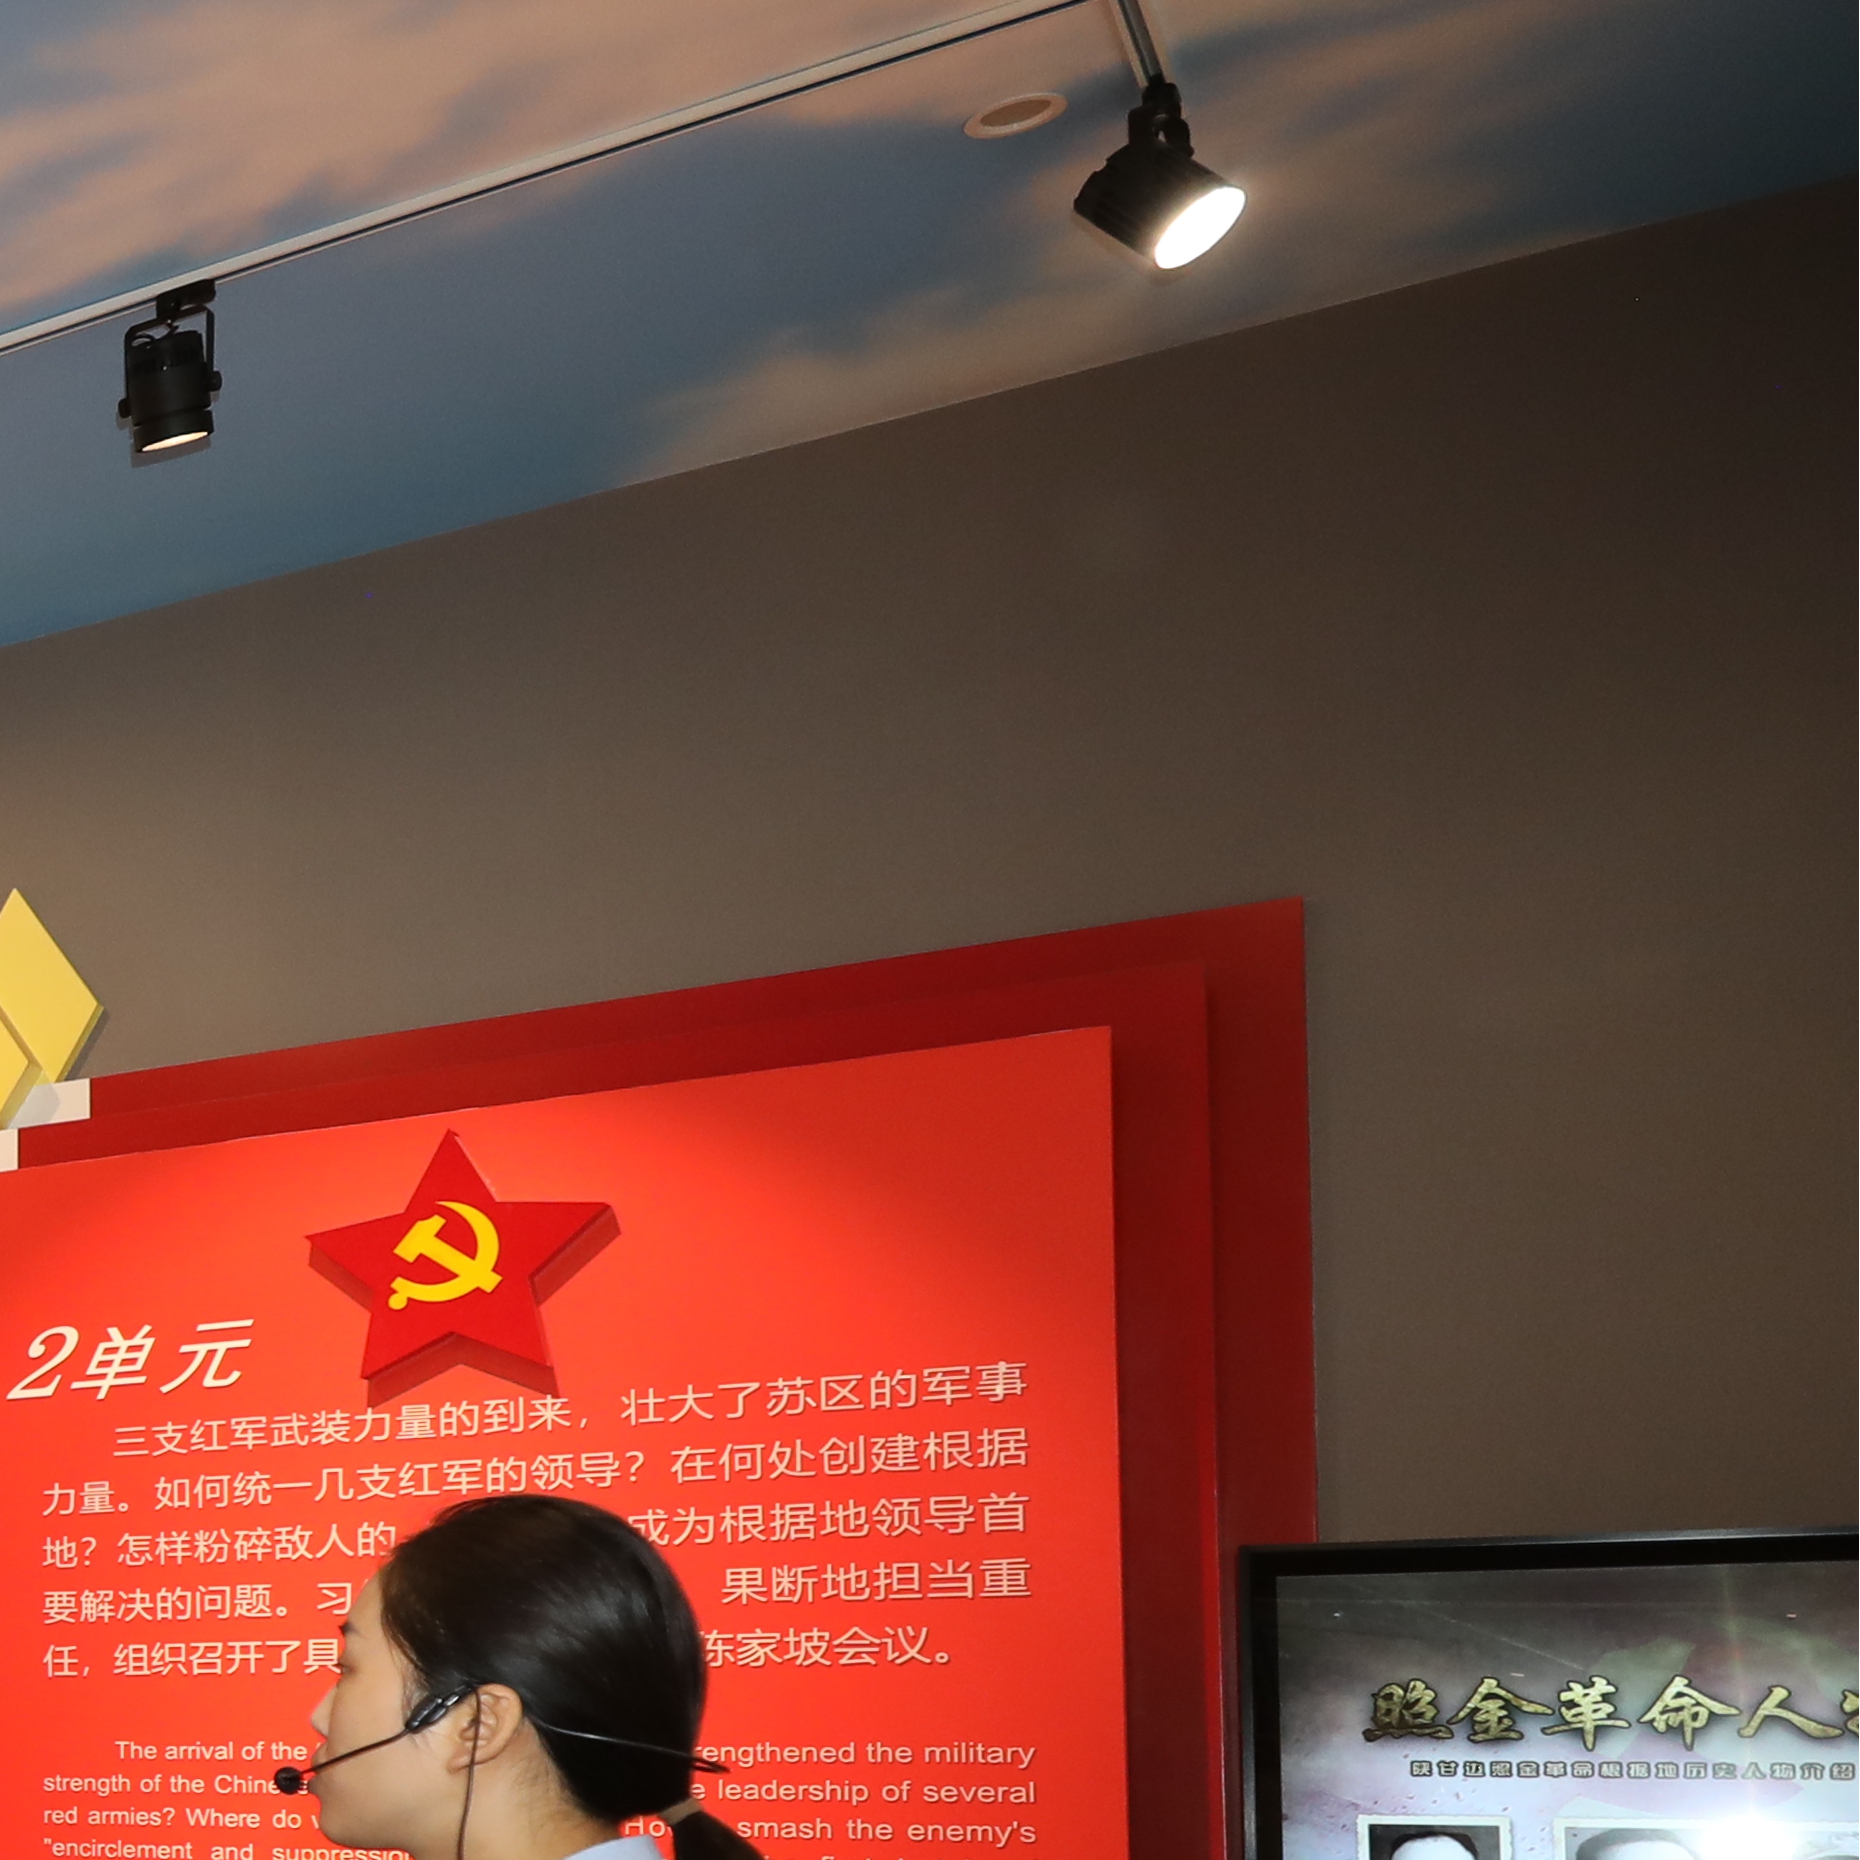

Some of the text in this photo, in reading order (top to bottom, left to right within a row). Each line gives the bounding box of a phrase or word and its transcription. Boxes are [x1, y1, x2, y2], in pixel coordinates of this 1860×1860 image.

[6, 1319, 255, 1401] 2单元
[112, 1361, 1029, 1460] 三支红军武装力量的到来，壮大了苏区的军事
[42, 1427, 1030, 1517] 力量。如何统一几支红军的领导？在何处创建根据
[720, 1557, 1032, 1605] 果断地担当重
[42, 1636, 342, 1680] 任，组织召开了具
[1362, 1675, 1860, 1752] 照金革命人
[115, 1741, 1035, 1768] The arrival of the rengthened the military
[43, 1774, 130, 1796] strength
[140, 1774, 161, 1794] of
[169, 1775, 205, 1794] the
[214, 1775, 309, 1796] Chinee
[718, 1780, 868, 1806] leadership
[882, 1780, 911, 1802] of
[923, 1781, 1036, 1804] several
[43, 1838, 193, 1860] "encirclement
[44, 1807, 77, 1826] red
[88, 1808, 175, 1827] armies?
[185, 1809, 260, 1829] Where
[272, 1810, 302, 1829] do
[737, 1820, 832, 1840] smash
[847, 1819, 893, 1841] the
[908, 1821, 1036, 1848] enemy's
